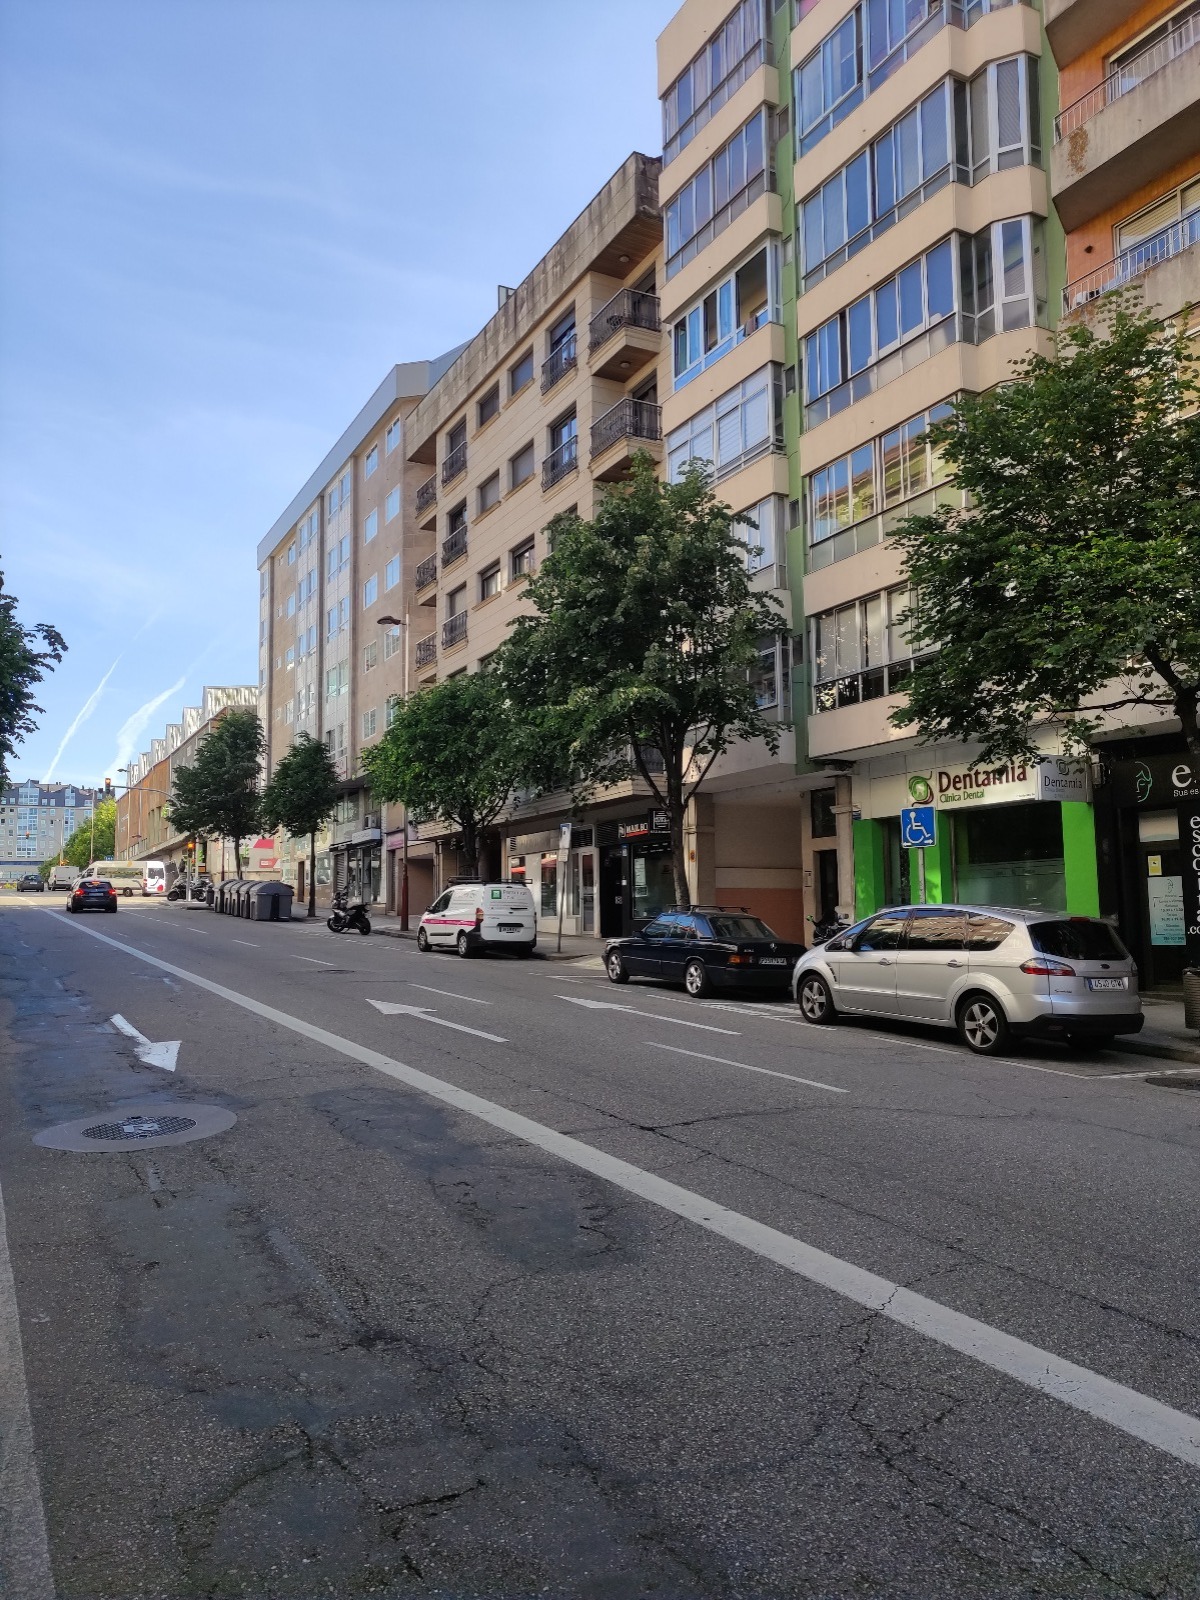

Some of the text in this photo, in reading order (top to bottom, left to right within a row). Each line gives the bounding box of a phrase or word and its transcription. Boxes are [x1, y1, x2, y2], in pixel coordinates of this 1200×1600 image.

[938, 764, 1027, 793] Dentamia
[1044, 775, 1083, 789] Dentamia
[940, 789, 985, 803] Clínica Dental
